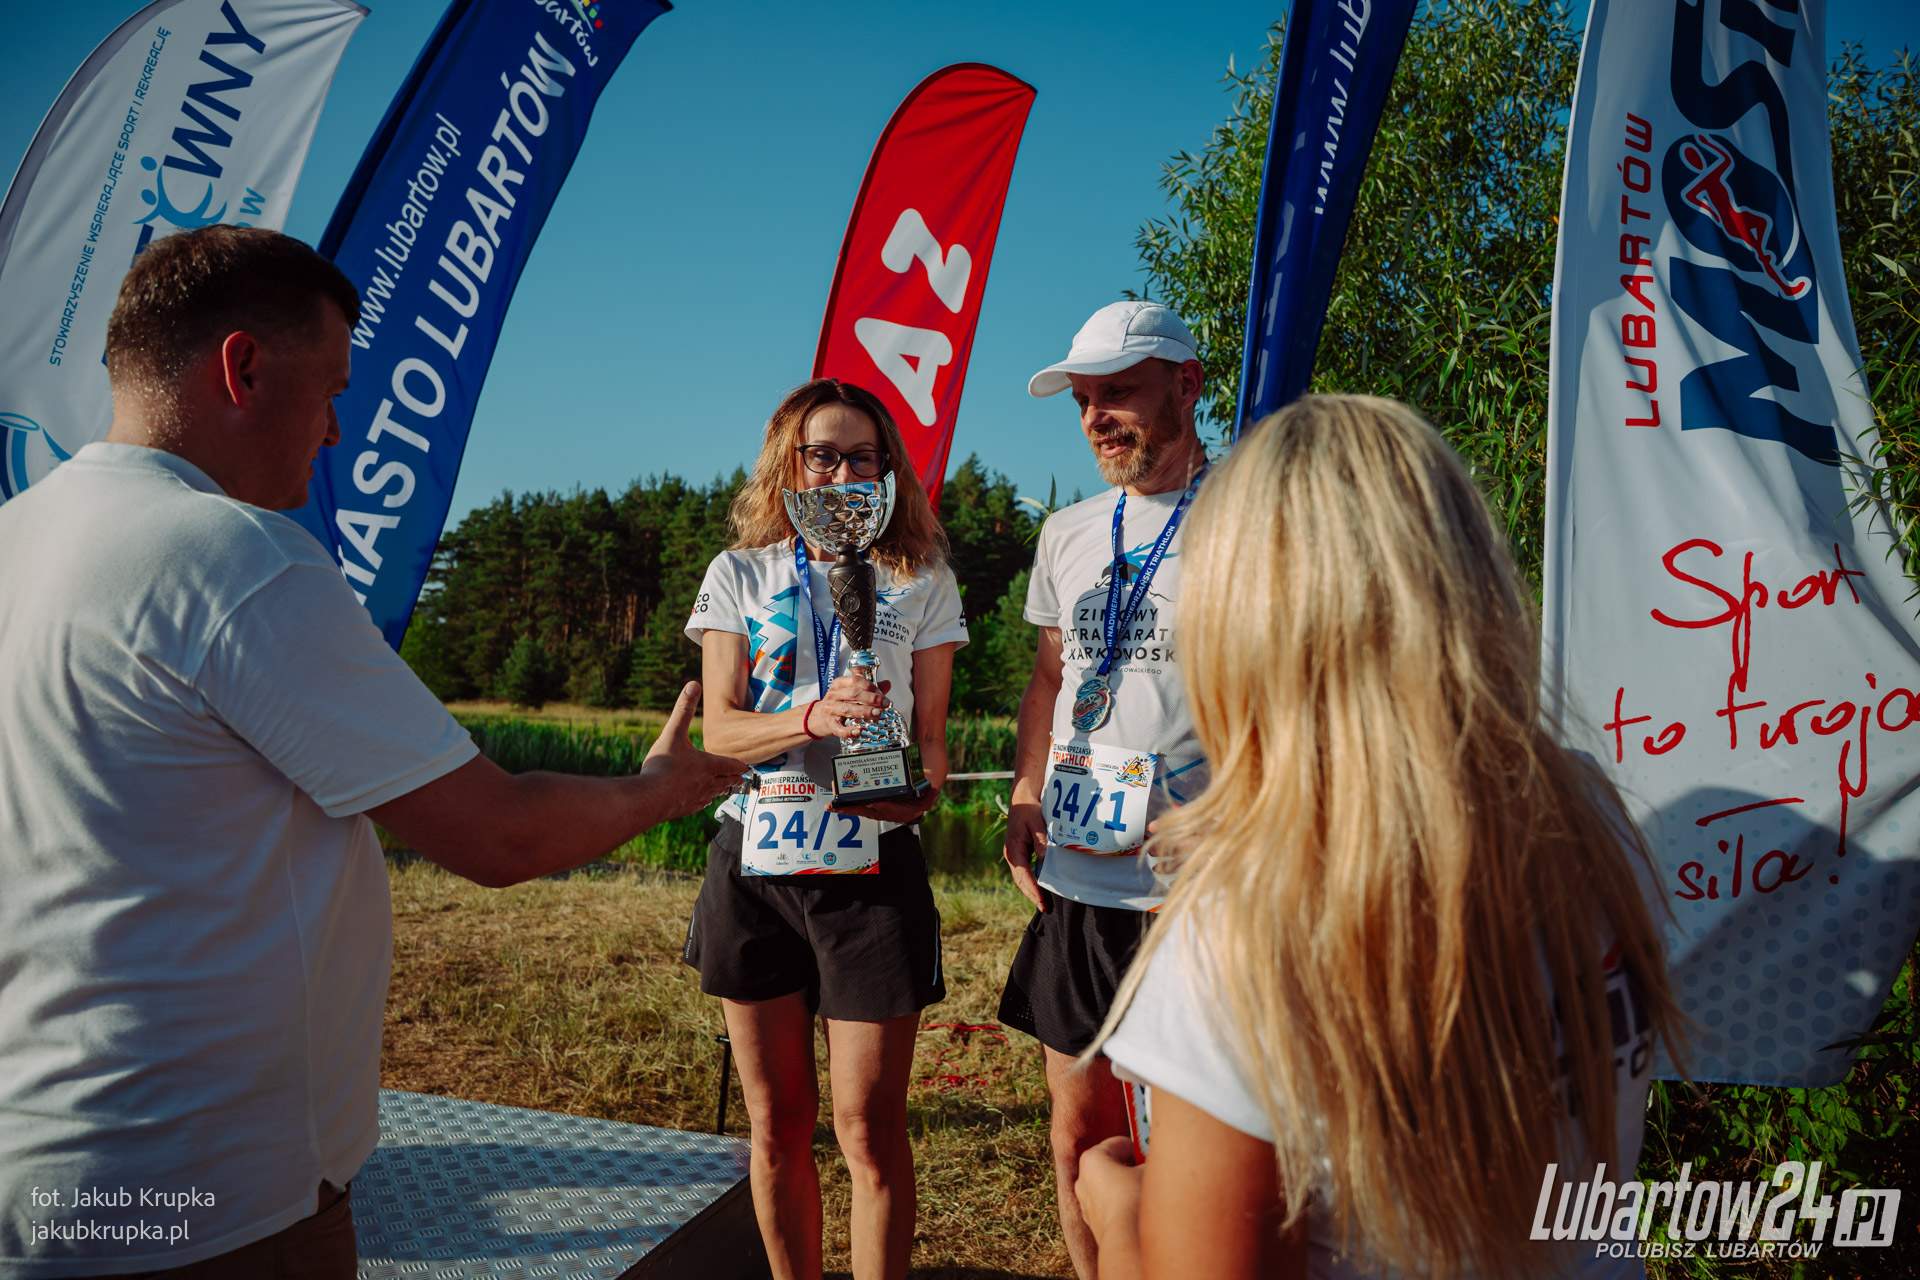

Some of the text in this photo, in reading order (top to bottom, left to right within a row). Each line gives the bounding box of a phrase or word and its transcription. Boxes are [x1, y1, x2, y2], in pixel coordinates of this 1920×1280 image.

[49, 246, 96, 367] STOWARZYSZENIE
[86, 153, 125, 244] WSPIERAJĄCE
[117, 109, 141, 152] SPORT
[137, 25, 172, 100] REKREACJĘ
[350, 113, 462, 350] www.lubartow.pl
[1617, 112, 1661, 428] LUBARTÓW
[335, 32, 577, 607] IASTO LUBARTÓW
[1151, 525, 1176, 566] TRIATHLON
[1650, 538, 1866, 692] Sport
[1603, 687, 1686, 764] to
[757, 810, 863, 850] 24/2
[1052, 778, 1127, 832] 24/1
